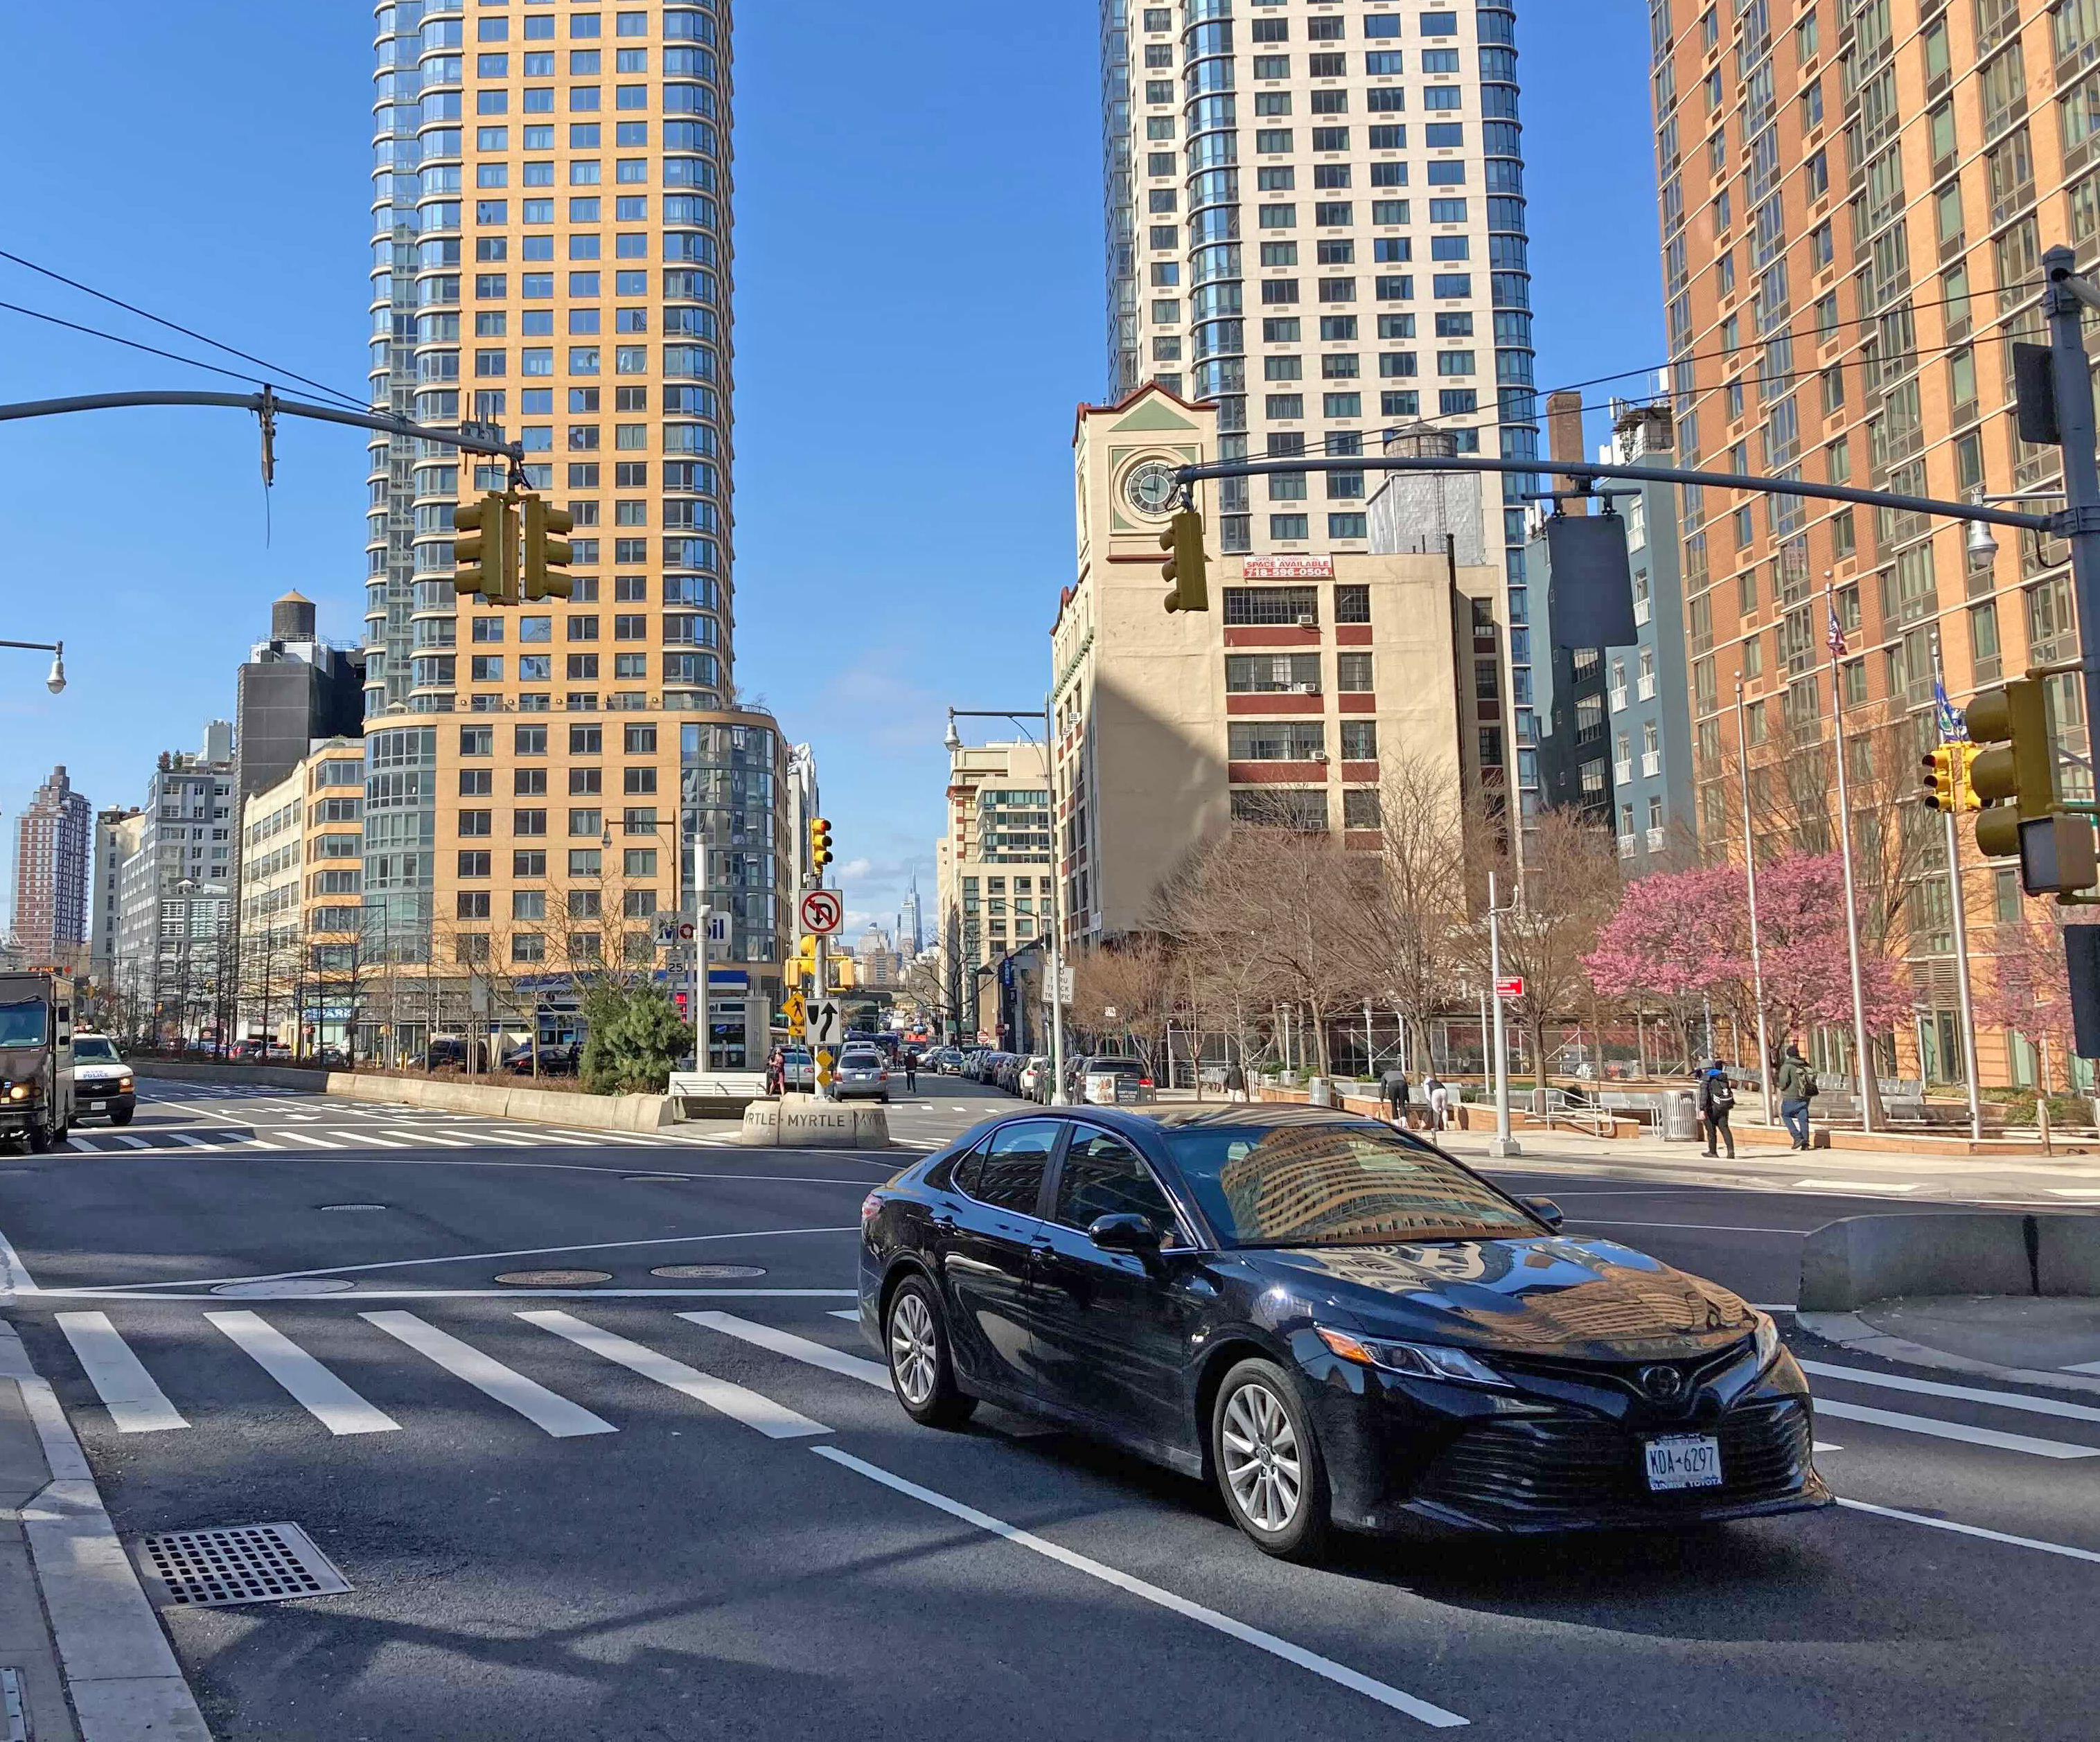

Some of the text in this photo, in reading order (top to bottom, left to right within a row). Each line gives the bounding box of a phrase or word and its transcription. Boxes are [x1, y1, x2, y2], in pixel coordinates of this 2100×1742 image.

[1246, 568, 1329, 576] 718-596-0504
[659, 918, 724, 939] Moil
[669, 963, 683, 972] 25
[788, 1114, 845, 1127] MYRTLE
[1688, 1479, 1722, 1487] TOYOTA
